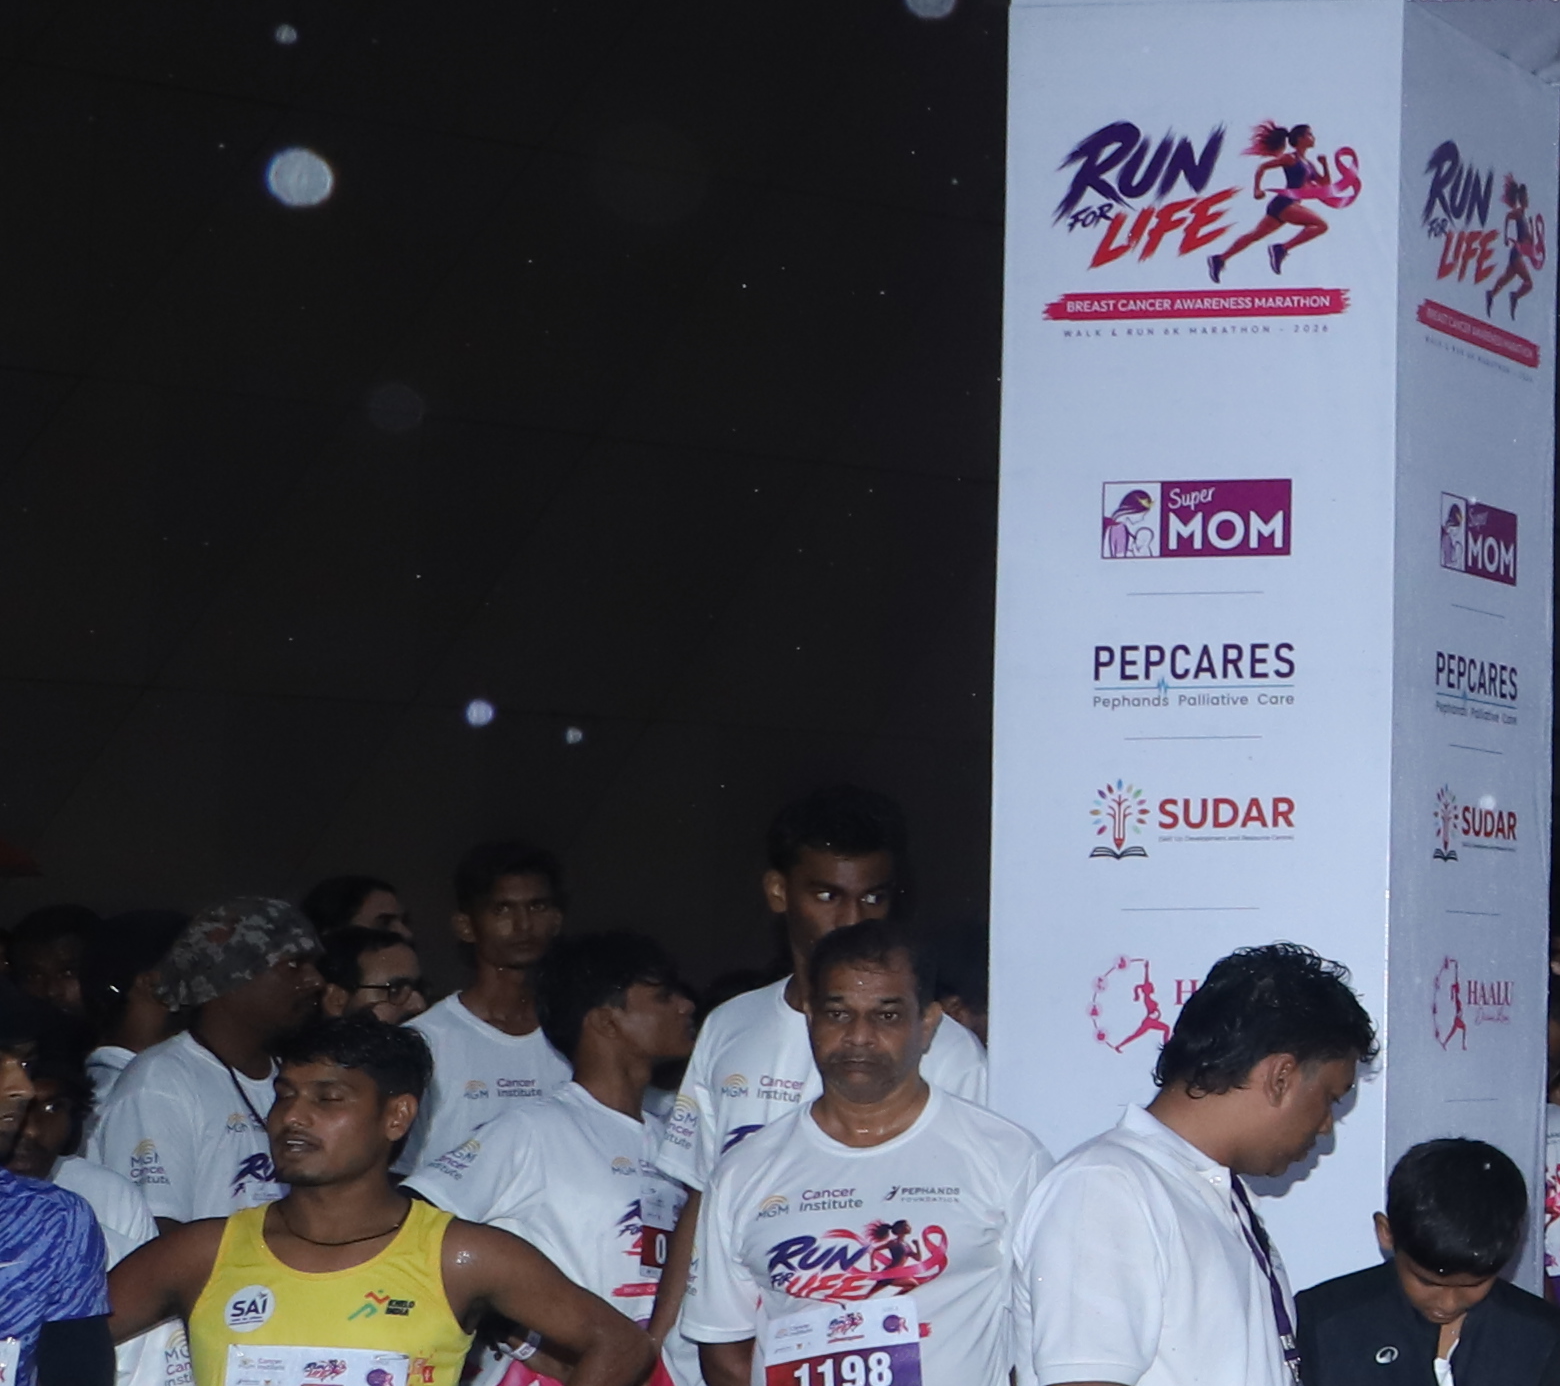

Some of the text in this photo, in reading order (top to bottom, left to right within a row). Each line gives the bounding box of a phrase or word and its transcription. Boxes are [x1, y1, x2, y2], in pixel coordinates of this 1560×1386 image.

[1053, 121, 1225, 225] RUN
[1421, 141, 1494, 233] RUN
[1067, 187, 1243, 270] FOR LIFE
[1437, 230, 1497, 284] LIFE
[1067, 295, 1331, 312] BREAST CANCER AWARENESS MARATHON
[1189, 325, 1271, 335] MARATHON
[1294, 324, 1329, 333] 2026
[1168, 486, 1216, 509] Super
[1168, 511, 1284, 550] MOM
[1468, 532, 1515, 578] MOM
[1093, 643, 1295, 681] PEPCARES
[1436, 651, 1518, 701] PEPCARES
[1093, 693, 1294, 710] Pephands Palliative Care
[1158, 797, 1295, 829] SUDAR
[1462, 806, 1517, 840] SUDAR
[1467, 980, 1514, 1005] HAALU
[756, 1198, 863, 1221] MGM Institute
[802, 1187, 856, 1200] Cancer
[766, 1235, 873, 1275] RUN
[231, 1299, 268, 1317] SAI
